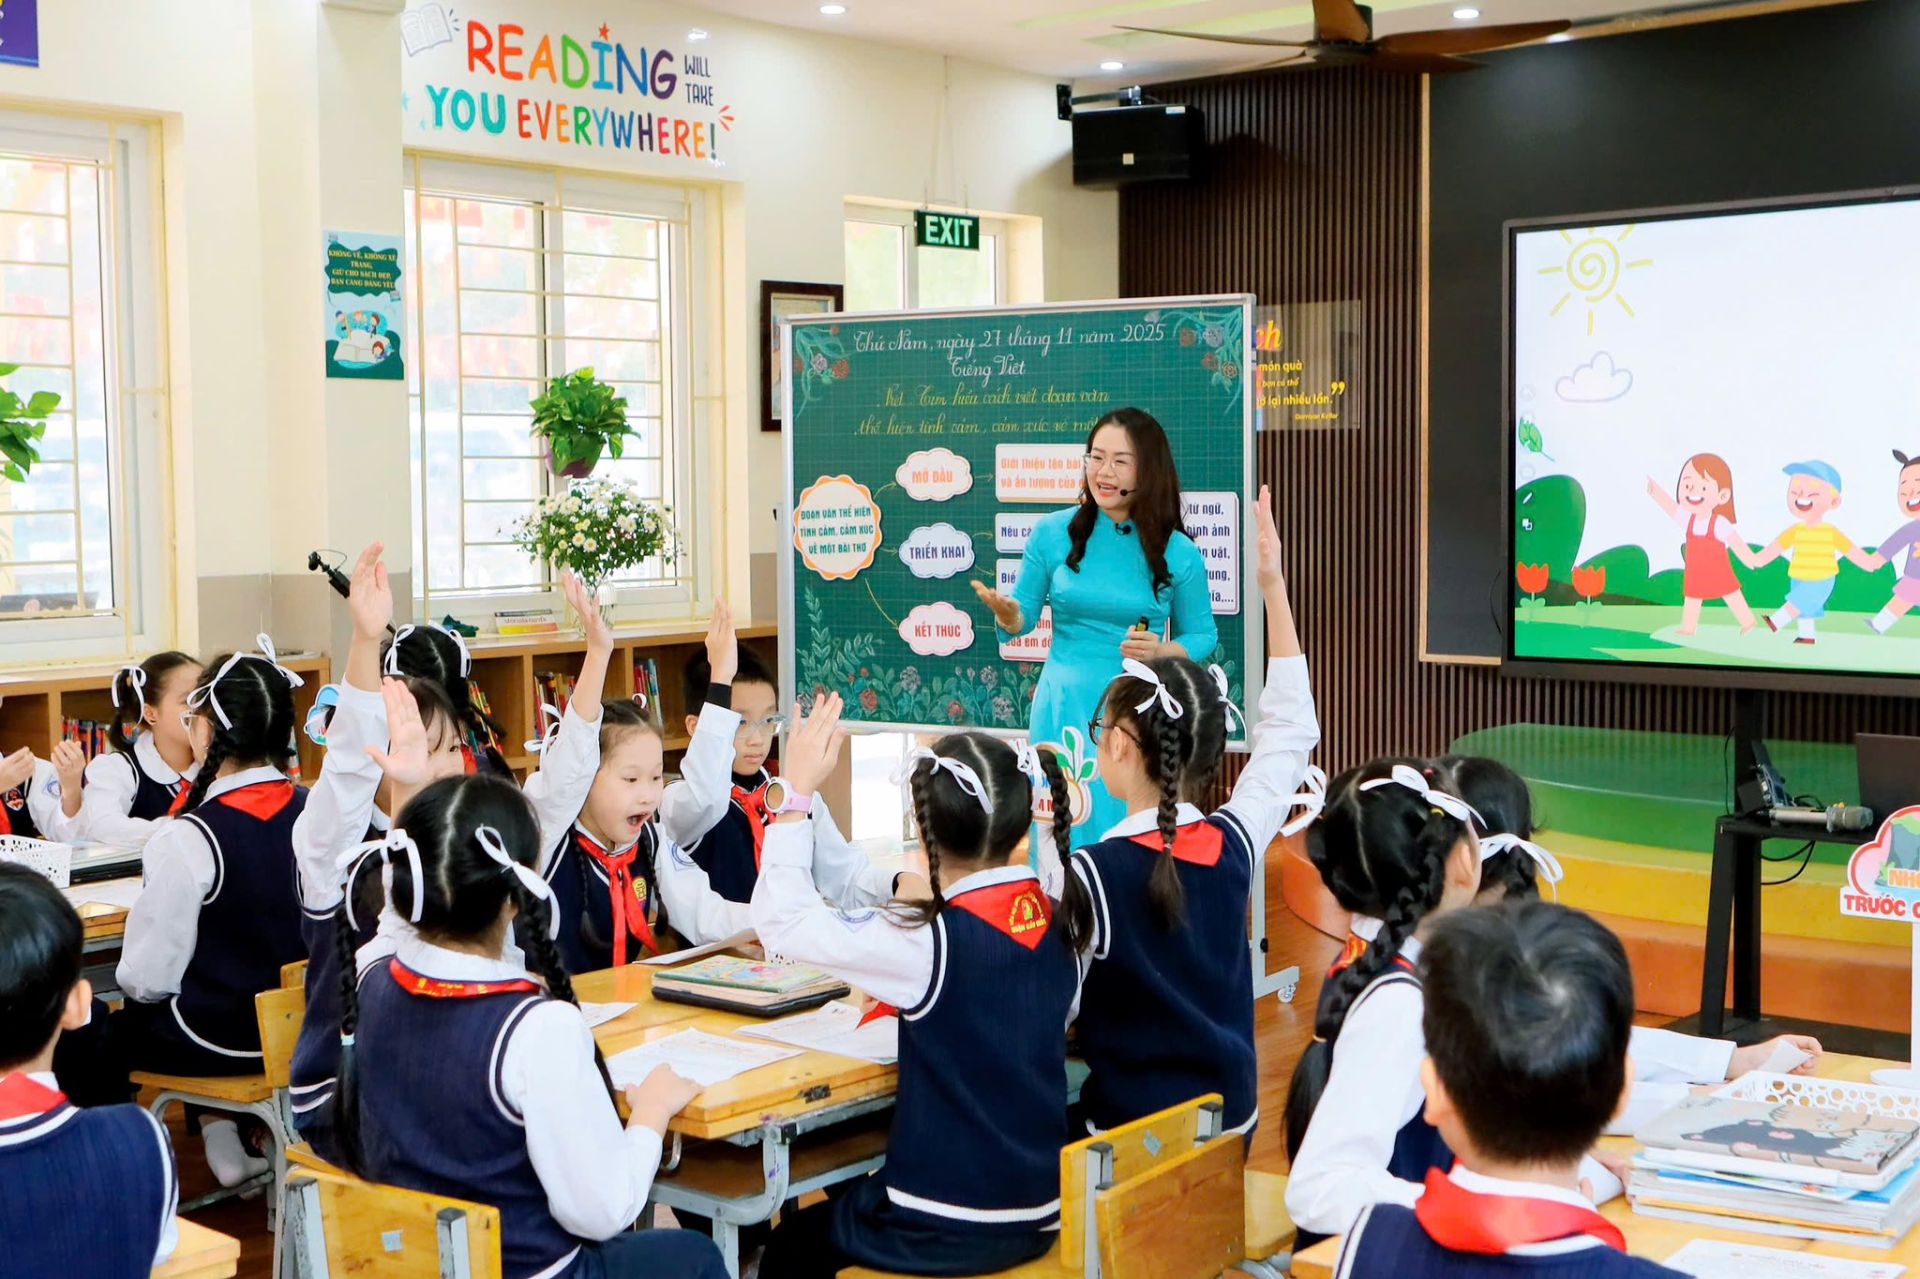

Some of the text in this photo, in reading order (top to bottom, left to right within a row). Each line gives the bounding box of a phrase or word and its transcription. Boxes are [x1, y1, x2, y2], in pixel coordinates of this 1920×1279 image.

[467, 20, 677, 100] READING
[684, 54, 711, 78] WILL
[685, 82, 714, 106] TAKE
[426, 84, 717, 159] YOU EVERYWHERE!
[925, 215, 973, 247] EXIT
[854, 330, 885, 353] Thứ
[937, 333, 975, 361] ngày
[979, 330, 1001, 348] 27
[1008, 324, 1051, 357] tháng
[1057, 326, 1073, 345] 11
[1080, 331, 1115, 343] năm
[1120, 323, 1168, 342] 2025
[950, 353, 1026, 388] Tiếng Việt
[1283, 359, 1303, 373] quà
[1001, 525, 1019, 538] Nêu
[1211, 522, 1230, 537] ảnh
[909, 541, 965, 560] TRIỂN KHAI
[914, 620, 961, 638] KẾT THÚC
[1024, 637, 1039, 648] em
[1844, 892, 1907, 917] TRƯỚC
